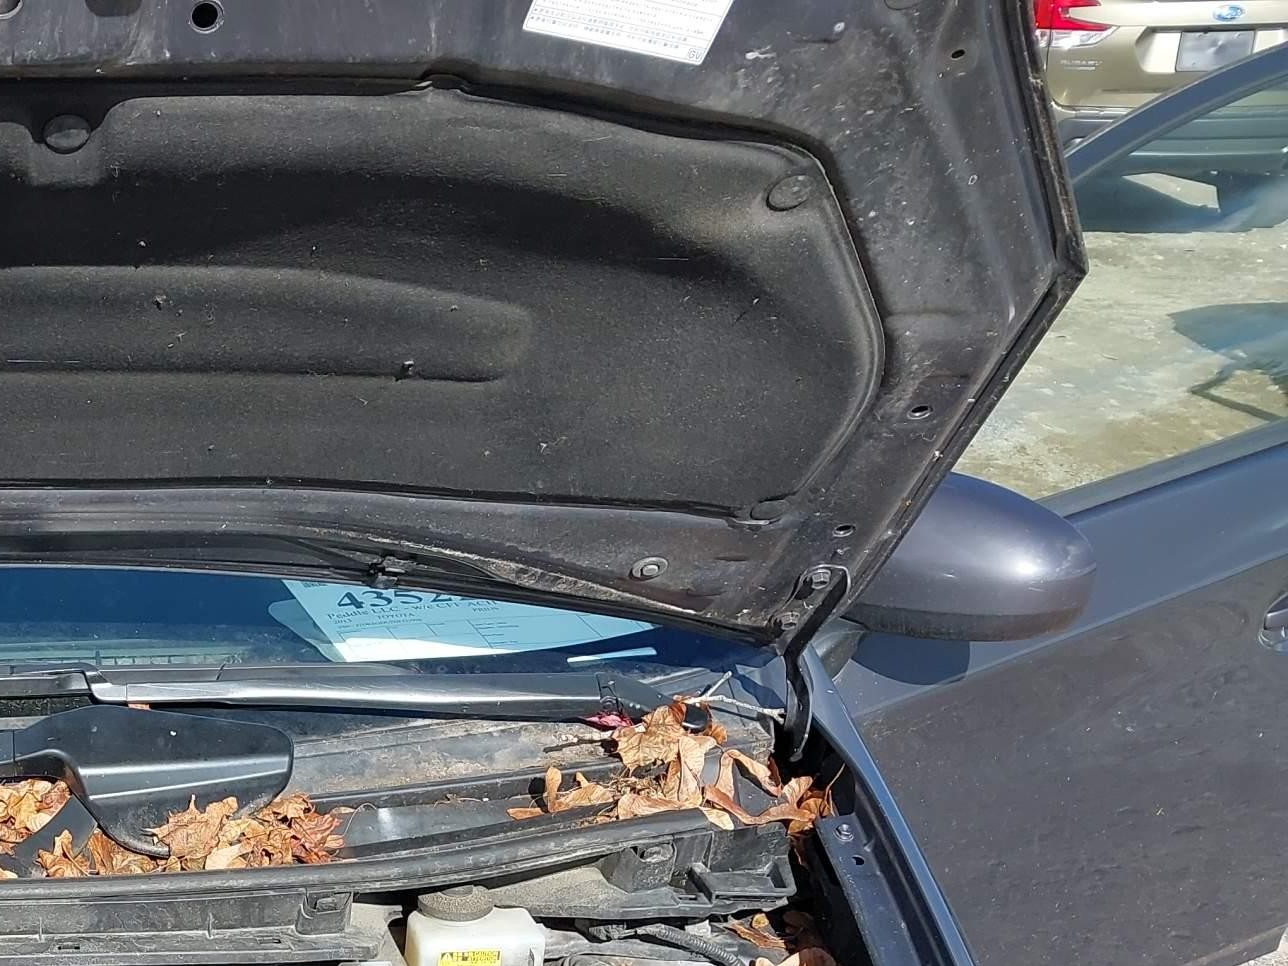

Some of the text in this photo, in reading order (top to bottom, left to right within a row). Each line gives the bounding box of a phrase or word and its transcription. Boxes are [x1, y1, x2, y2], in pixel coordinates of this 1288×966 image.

[327, 609, 368, 620] Peddle
[371, 606, 400, 615] LLC
[377, 612, 415, 620] TOYOTA
